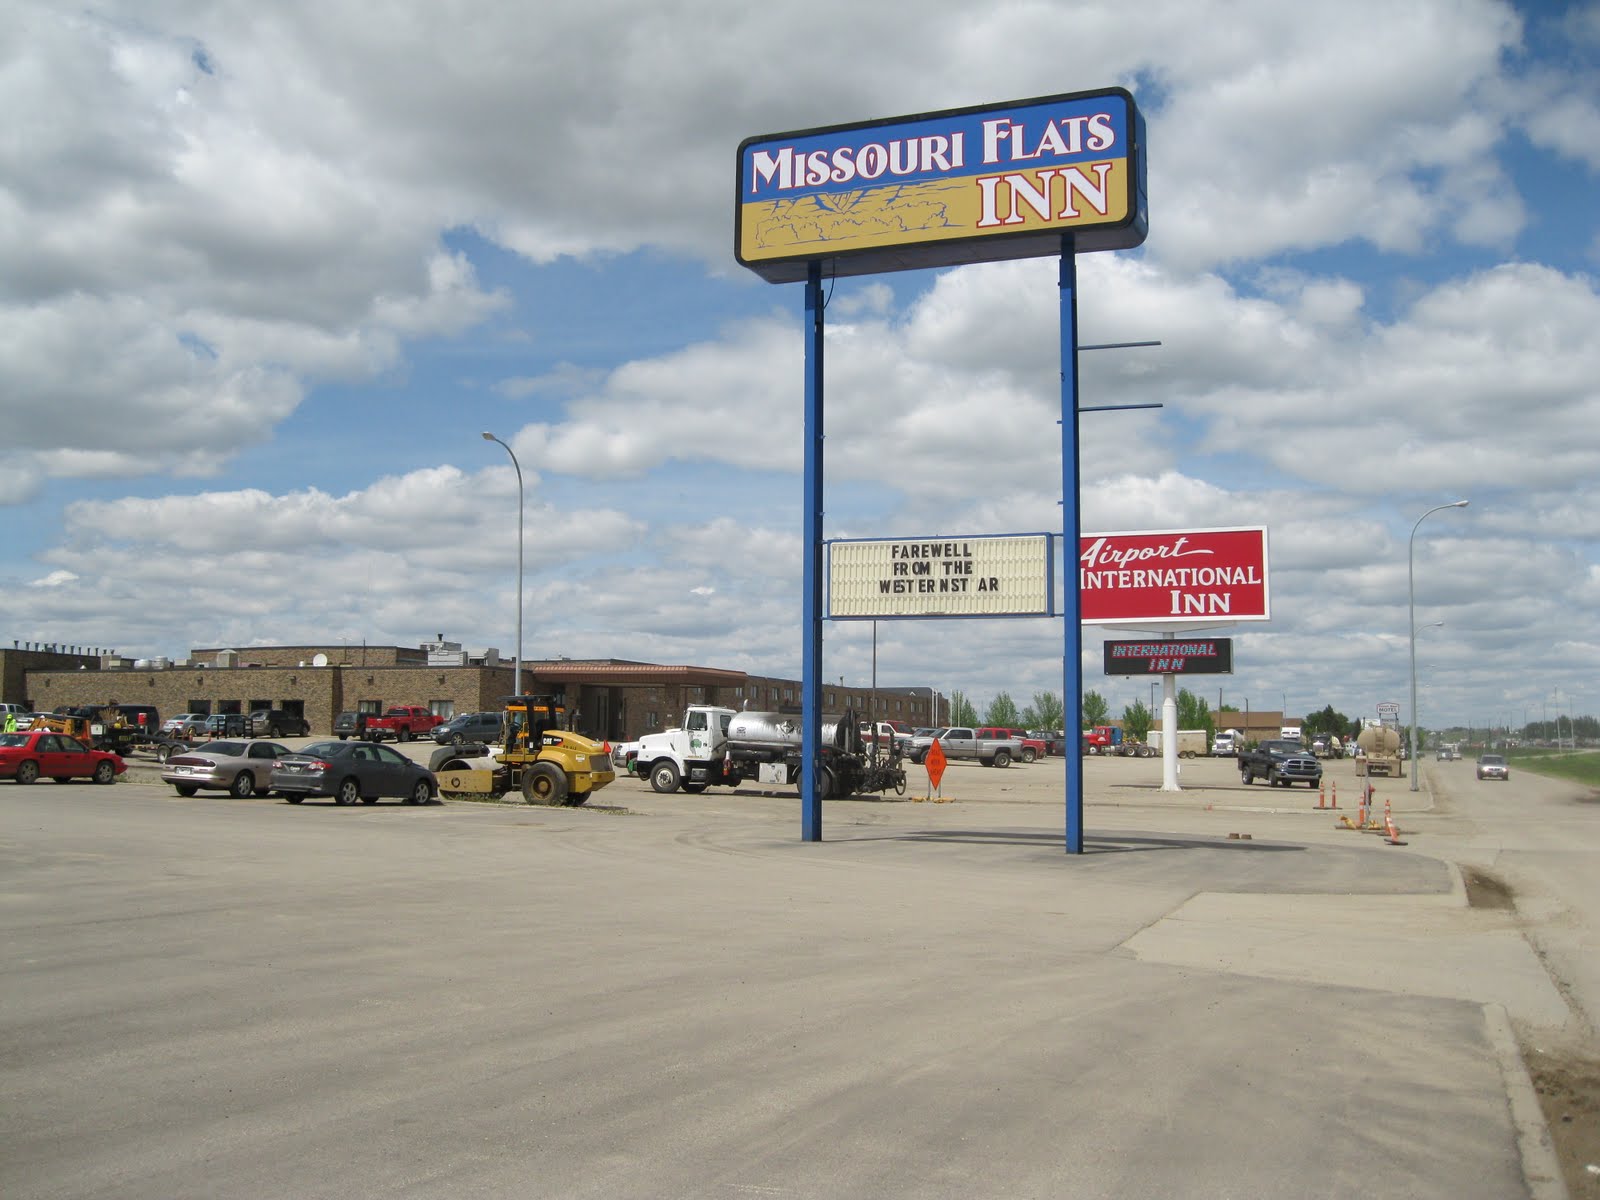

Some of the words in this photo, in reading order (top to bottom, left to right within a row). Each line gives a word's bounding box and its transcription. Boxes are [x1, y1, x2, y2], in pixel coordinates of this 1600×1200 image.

[751, 132, 964, 193] MISSOURI
[982, 113, 1115, 164] FLATS
[976, 162, 1113, 228] INN
[892, 543, 972, 559] FAREWELL
[1080, 537, 1214, 568] Airport
[893, 561, 931, 576] FROM
[942, 560, 973, 575] THE
[1080, 566, 1262, 590] INTERNATIONAL
[1170, 590, 1231, 614] INN
[1111, 643, 1216, 657] INTERNATIONAL
[1149, 658, 1185, 671] INN
[543, 737, 552, 745] CAT
